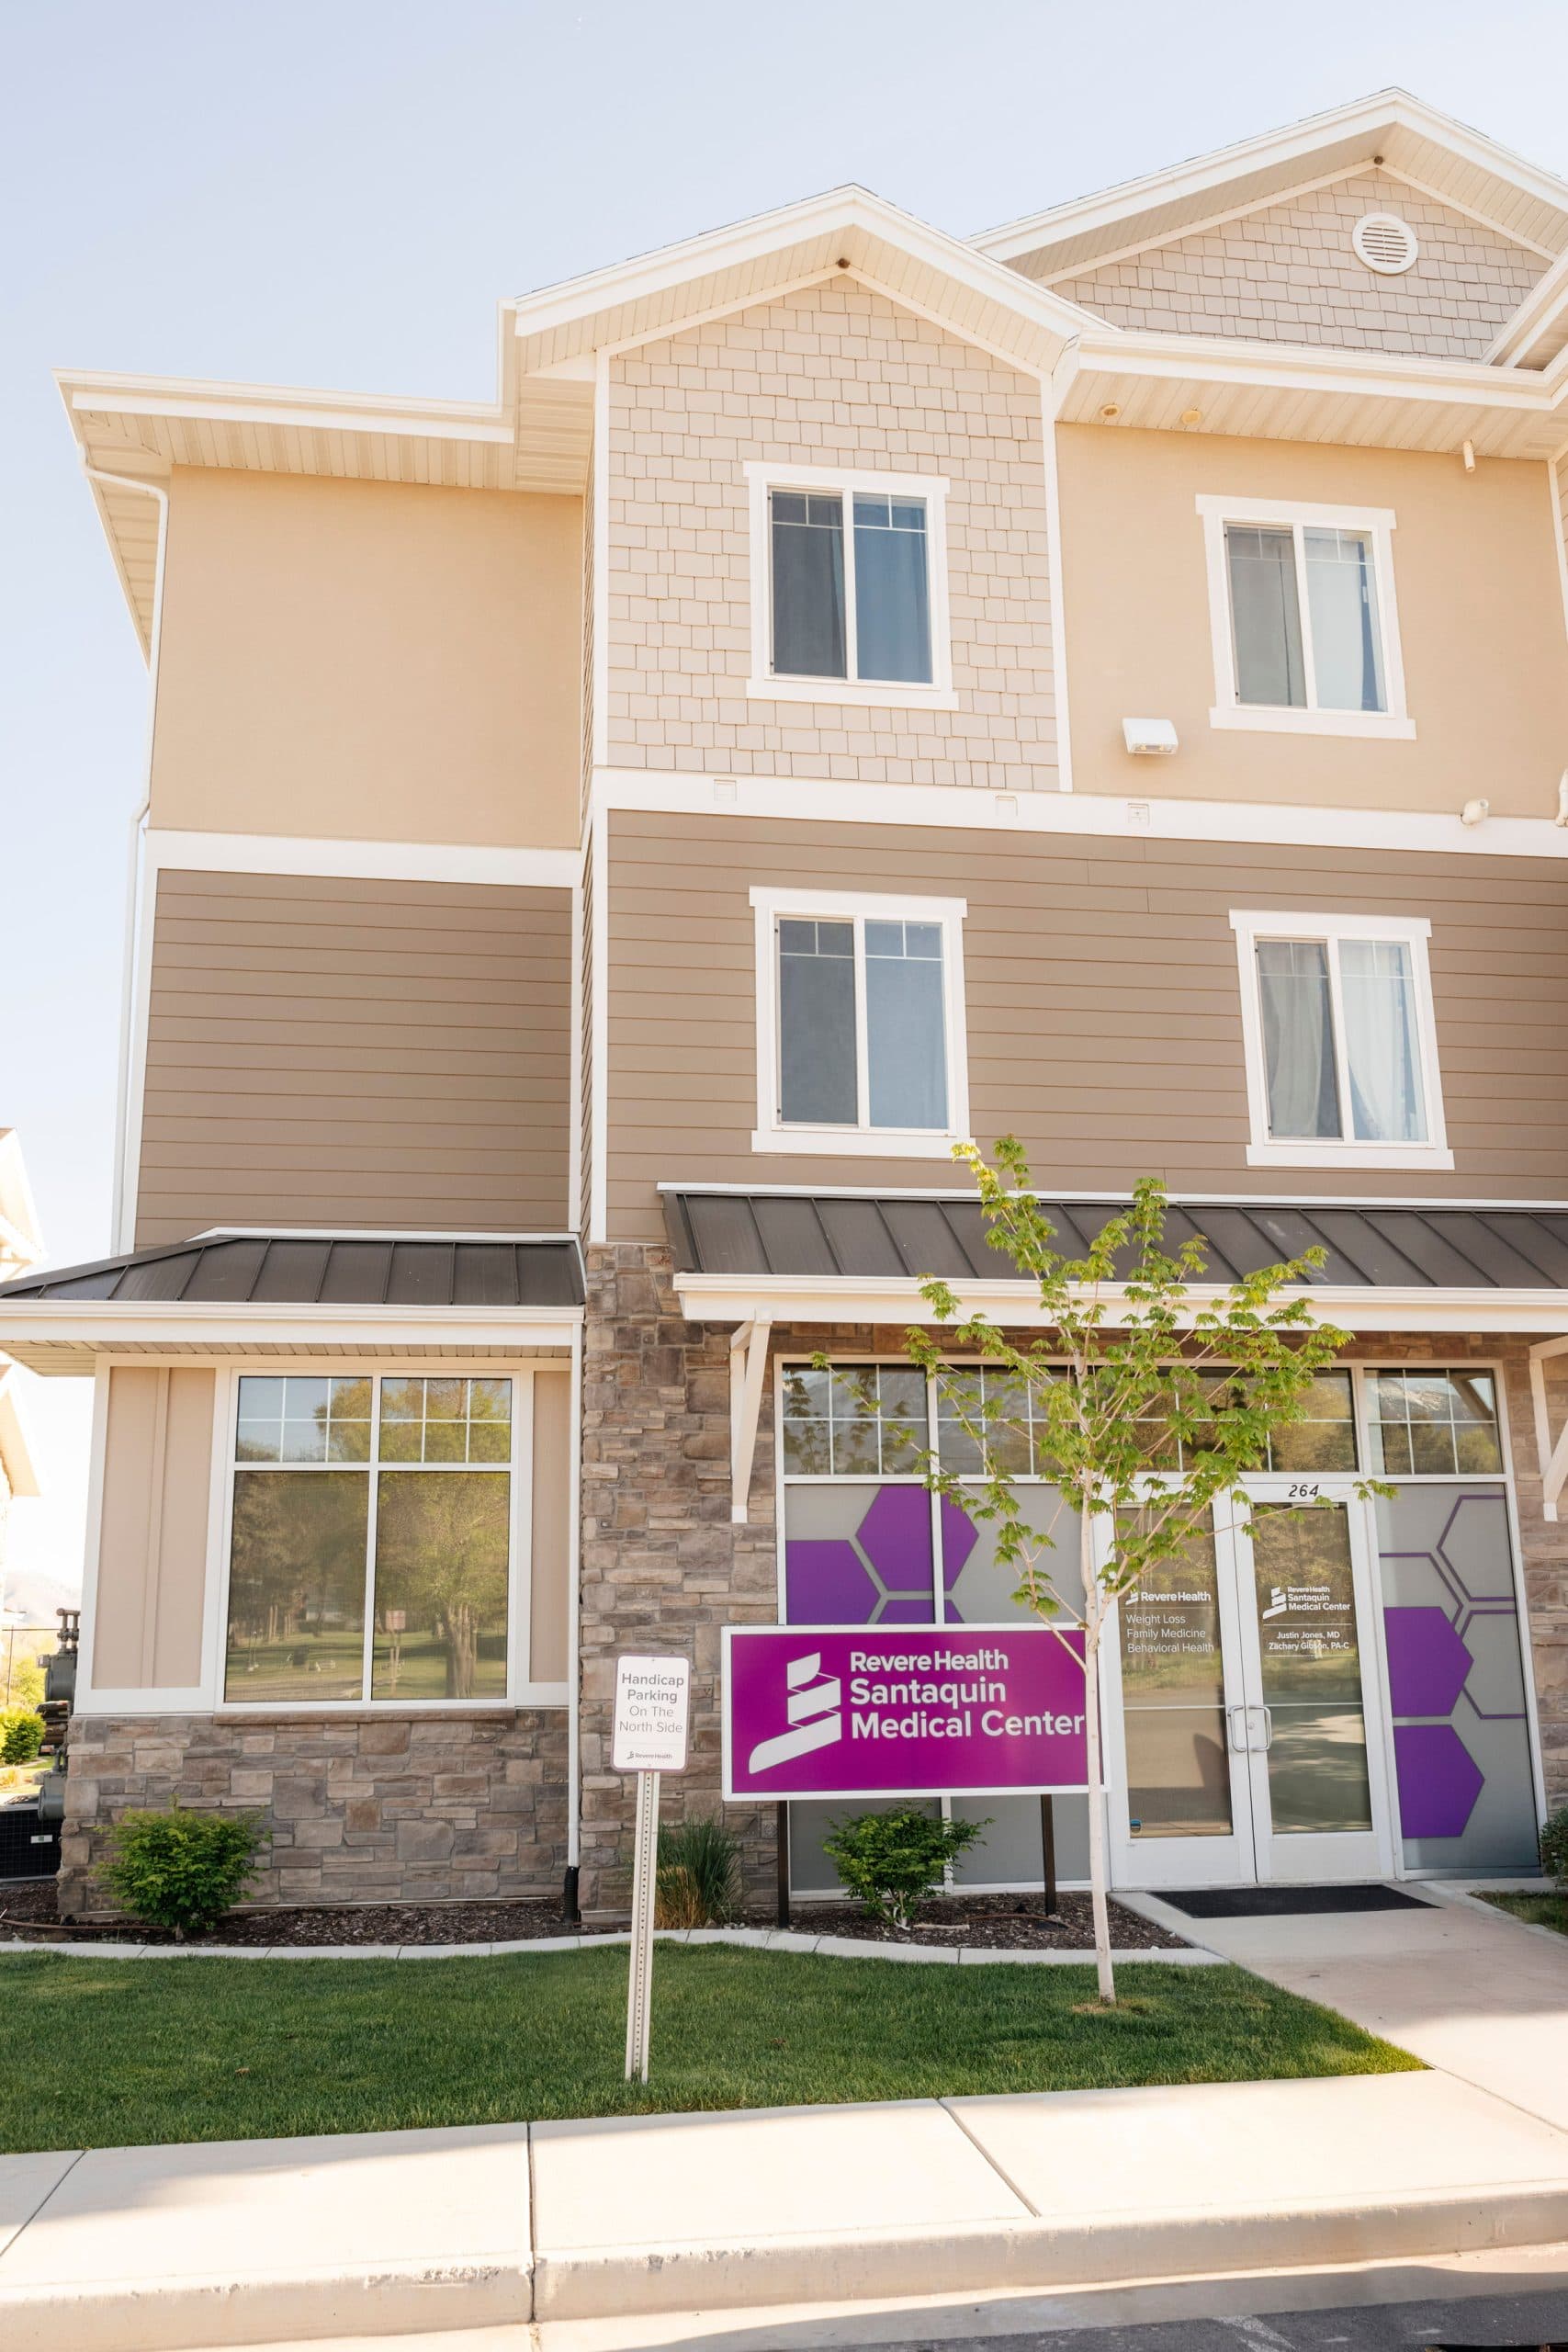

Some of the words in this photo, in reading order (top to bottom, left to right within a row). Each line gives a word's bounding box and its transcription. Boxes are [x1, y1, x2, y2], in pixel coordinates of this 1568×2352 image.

[1288, 1484, 1319, 1497] 264
[1288, 1593, 1330, 1602] Santaquin
[1289, 1602, 1321, 1611] Medical
[1126, 1614, 1160, 1625] Weight
[1163, 1614, 1186, 1623] Loss
[1127, 1628, 1158, 1640] Family
[1161, 1628, 1206, 1638] Medicine
[1301, 1631, 1325, 1640] Jones,
[1127, 1643, 1180, 1653] Behavioral
[1182, 1643, 1214, 1653] Health
[1269, 1642, 1299, 1651] Zachary
[1331, 1641, 1350, 1649] PA-C
[622, 1673, 684, 1688] Handicap
[627, 1690, 677, 1704] Parking
[850, 1677, 1007, 1711] Santaquin
[629, 1706, 648, 1716] On
[651, 1706, 674, 1717] The
[619, 1721, 652, 1732] North
[656, 1722, 683, 1733] Side
[852, 1711, 972, 1739] Medical
[981, 1710, 1086, 1736] Center
